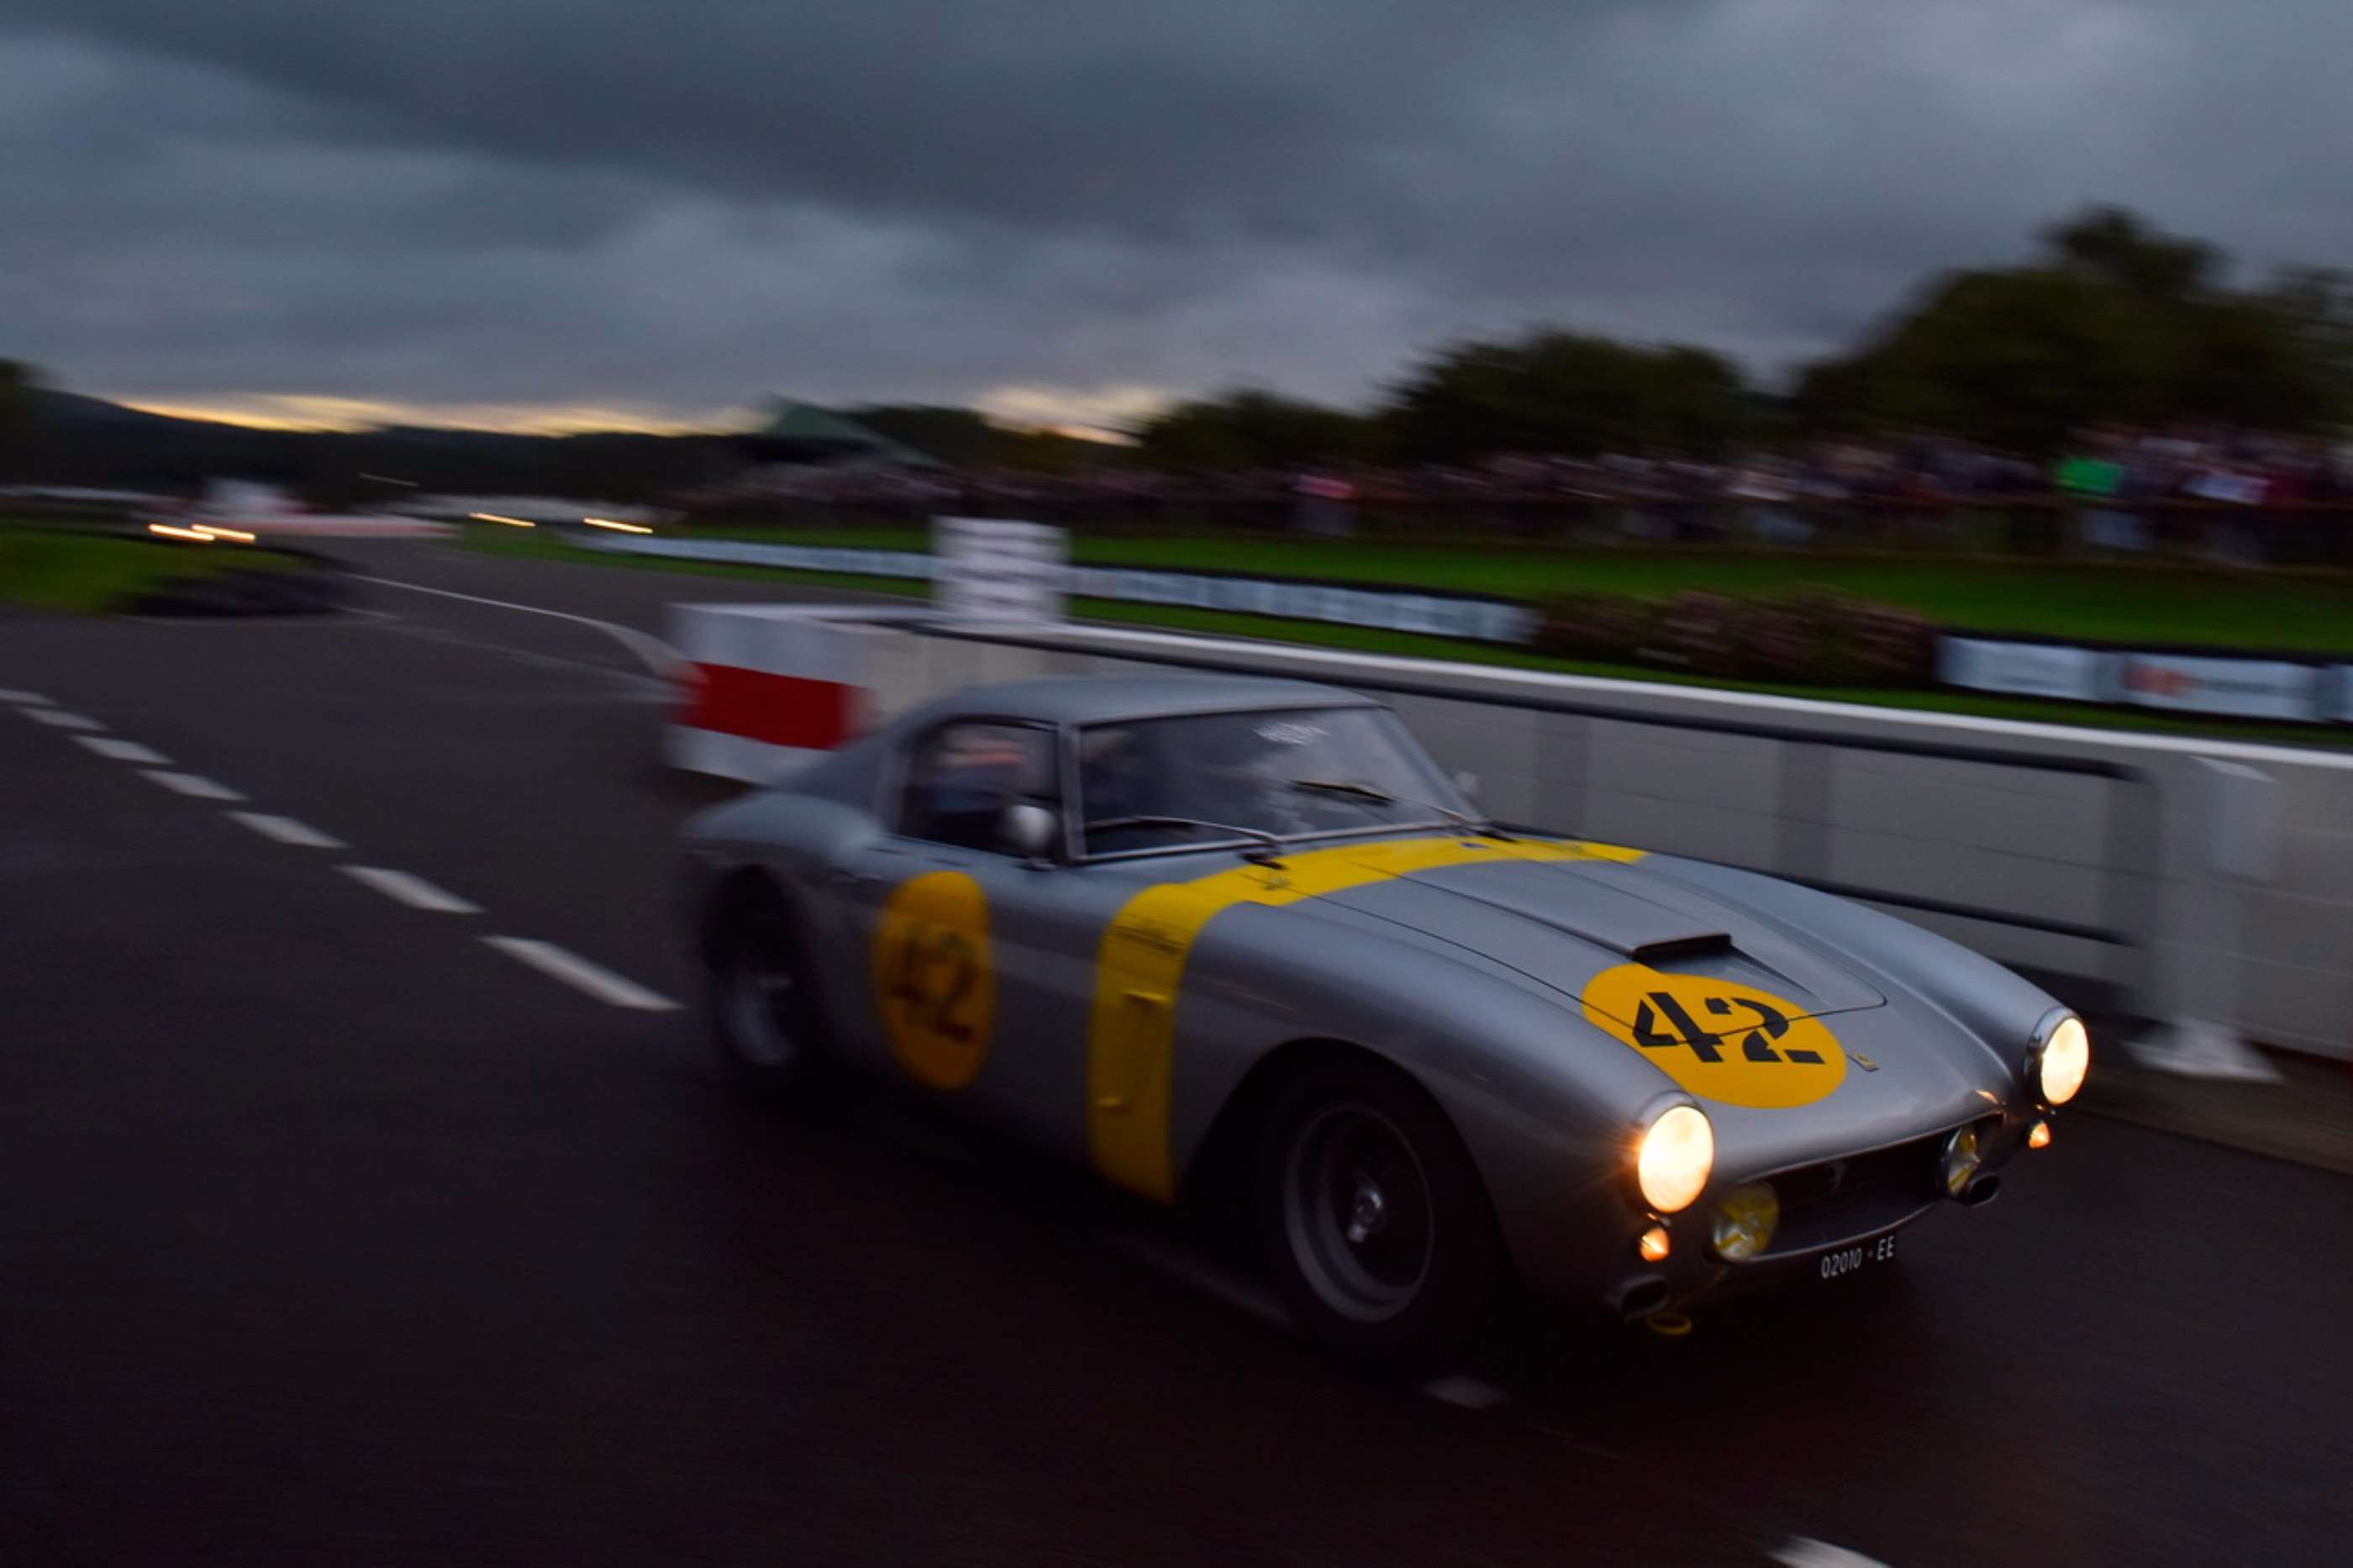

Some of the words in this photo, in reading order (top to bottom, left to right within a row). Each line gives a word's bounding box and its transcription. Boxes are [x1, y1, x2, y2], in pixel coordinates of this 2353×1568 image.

[885, 931, 976, 1044] 42
[1633, 992, 1825, 1065] 42
[1877, 1235, 1896, 1261] EE
